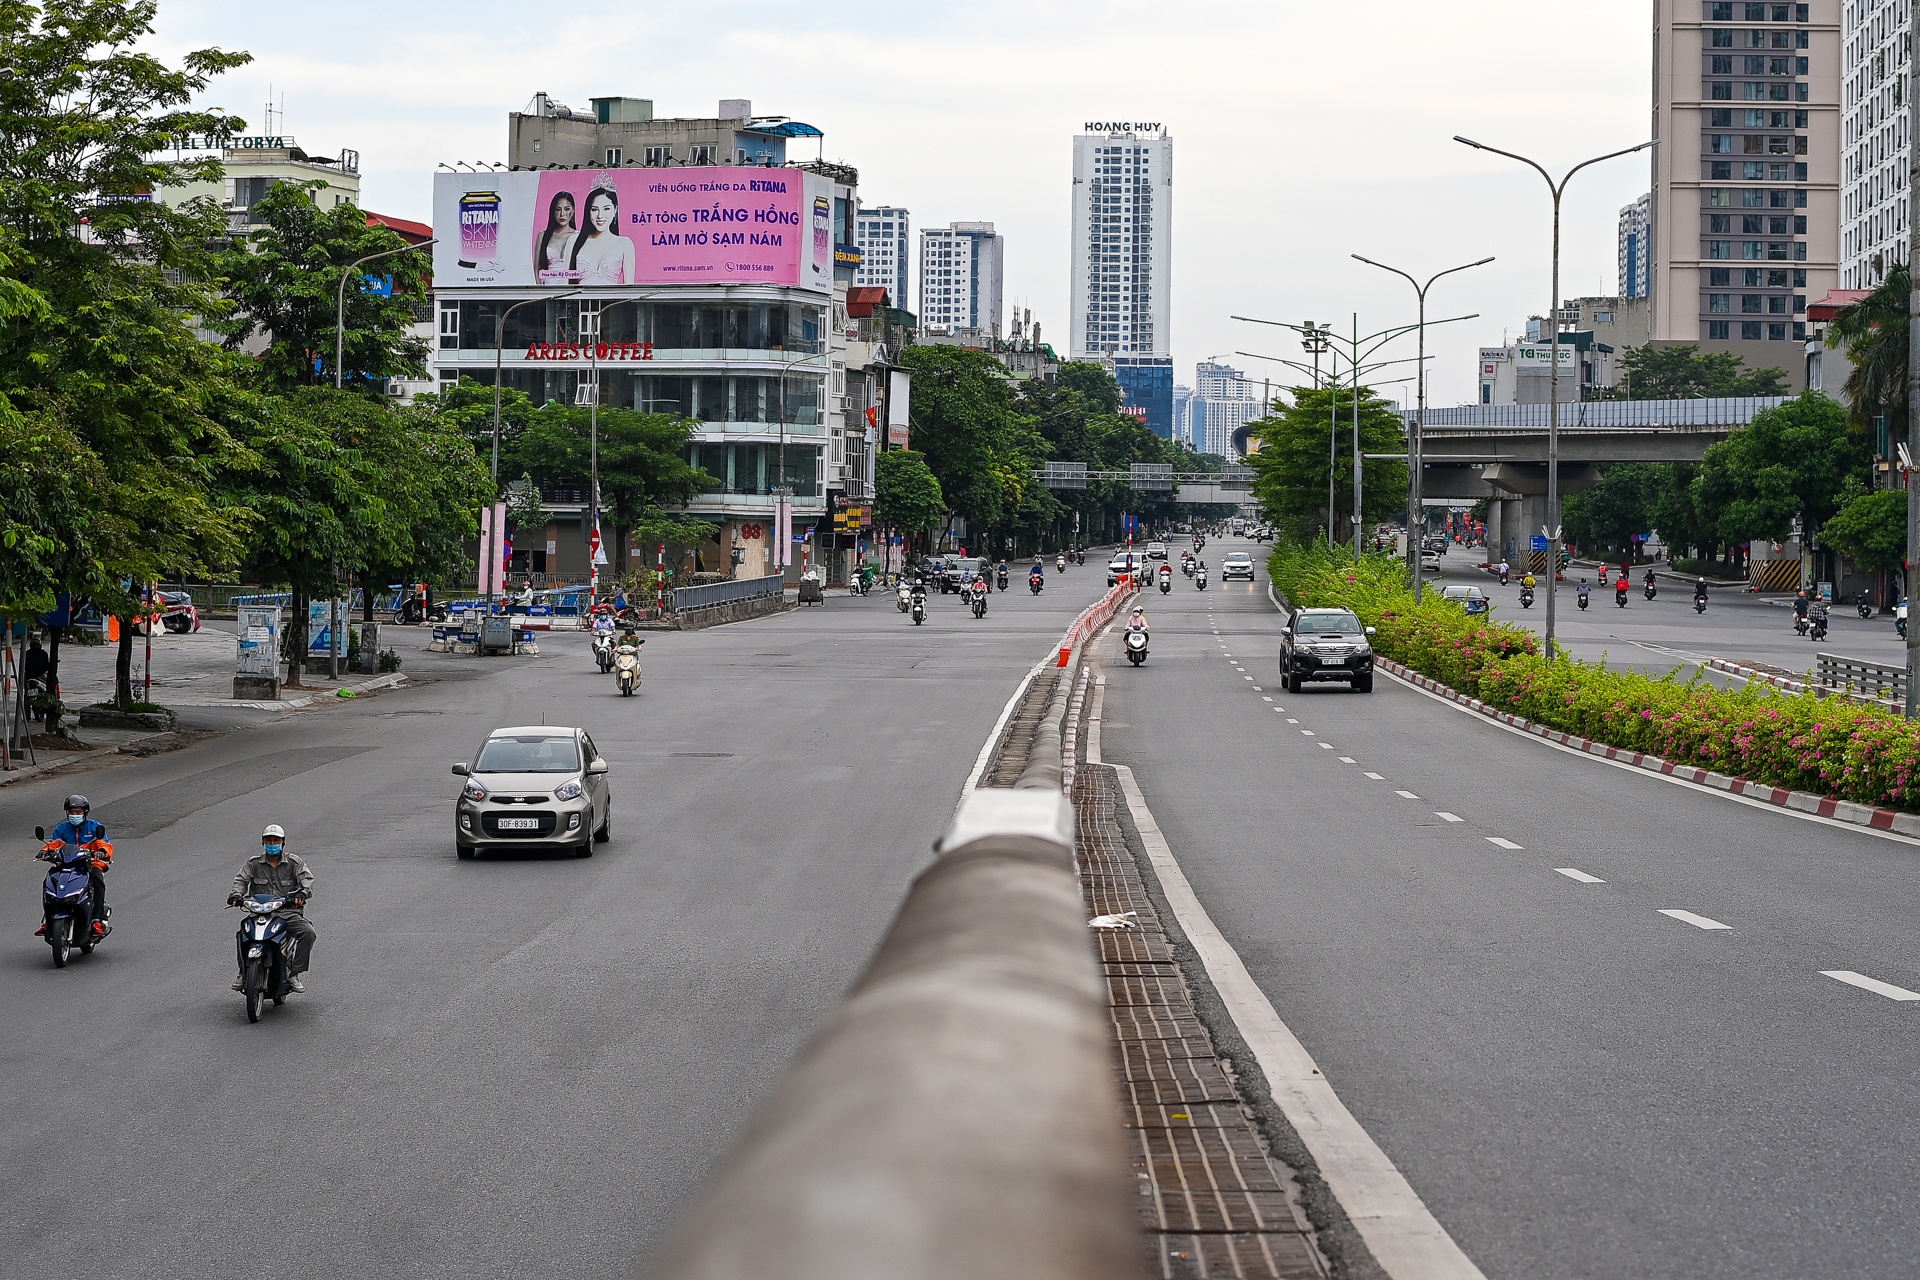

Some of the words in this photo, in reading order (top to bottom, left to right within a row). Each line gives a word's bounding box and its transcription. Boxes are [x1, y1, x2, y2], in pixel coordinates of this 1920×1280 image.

[1085, 122, 1130, 131] HOANG
[1134, 122, 1161, 131] HUY
[204, 136, 285, 149] VICTORYA
[648, 182, 668, 192] VIÊN
[671, 181, 697, 192] UỐNG
[700, 180, 730, 192] TRẮNG
[733, 183, 746, 192] DA
[632, 211, 652, 226] BẬT
[656, 211, 688, 223] TÔNG
[692, 202, 749, 222] TRẮNG
[754, 203, 800, 225] HỒNG
[462, 223, 498, 240] SKIN
[652, 230, 680, 246] LÀM
[685, 230, 708, 245] MỜ
[712, 232, 745, 248] SẠM
[750, 230, 782, 246] NÁM
[525, 343, 580, 360] ARIES
[583, 342, 654, 360] COFFEE
[742, 524, 761, 539] 93
